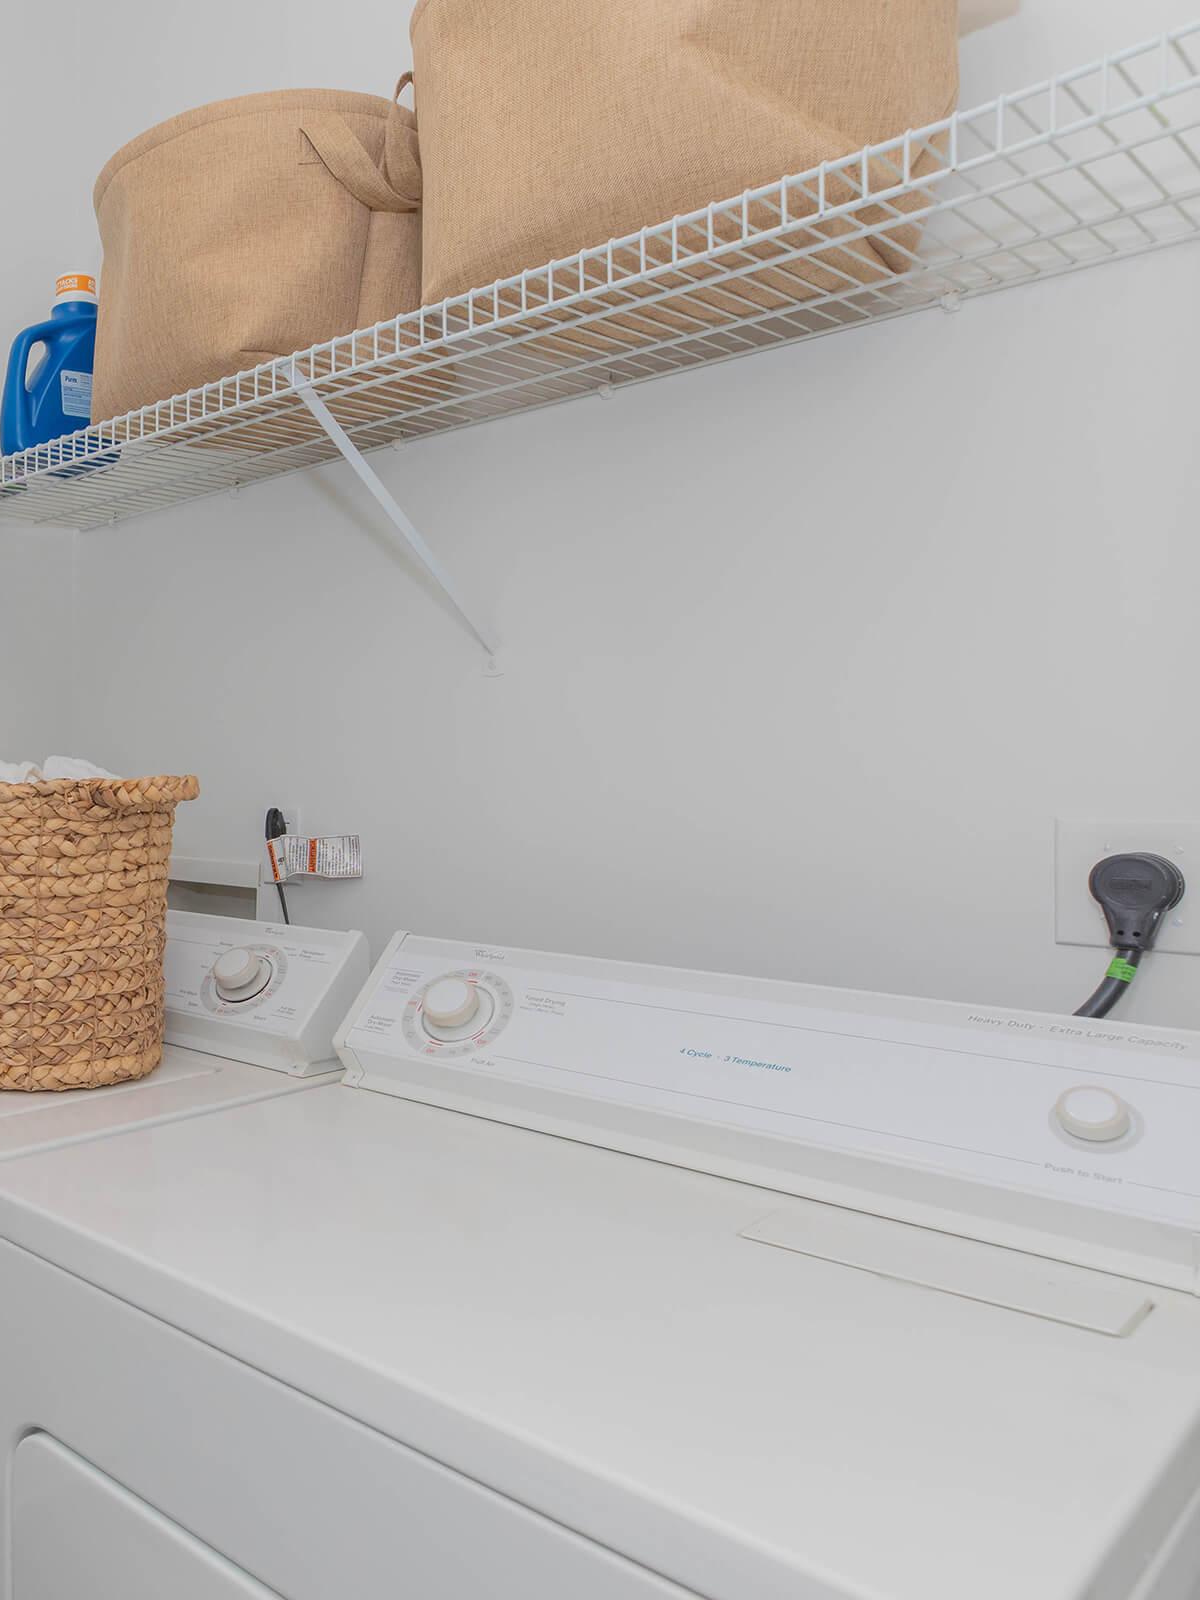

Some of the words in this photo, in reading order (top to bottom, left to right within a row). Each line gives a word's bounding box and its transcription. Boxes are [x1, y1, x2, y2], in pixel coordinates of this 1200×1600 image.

[968, 1015, 1003, 1026] Heavy
[1007, 1020, 1035, 1030] Duty
[1049, 1025, 1083, 1036] Extra
[1087, 1031, 1124, 1041] Large
[1128, 1035, 1188, 1051] Capacity
[687, 1049, 713, 1059] Cycle
[731, 1056, 792, 1072] Temperature
[1044, 1162, 1074, 1174] Push
[1077, 1168, 1090, 1177] to
[1093, 1172, 1123, 1184] Start
